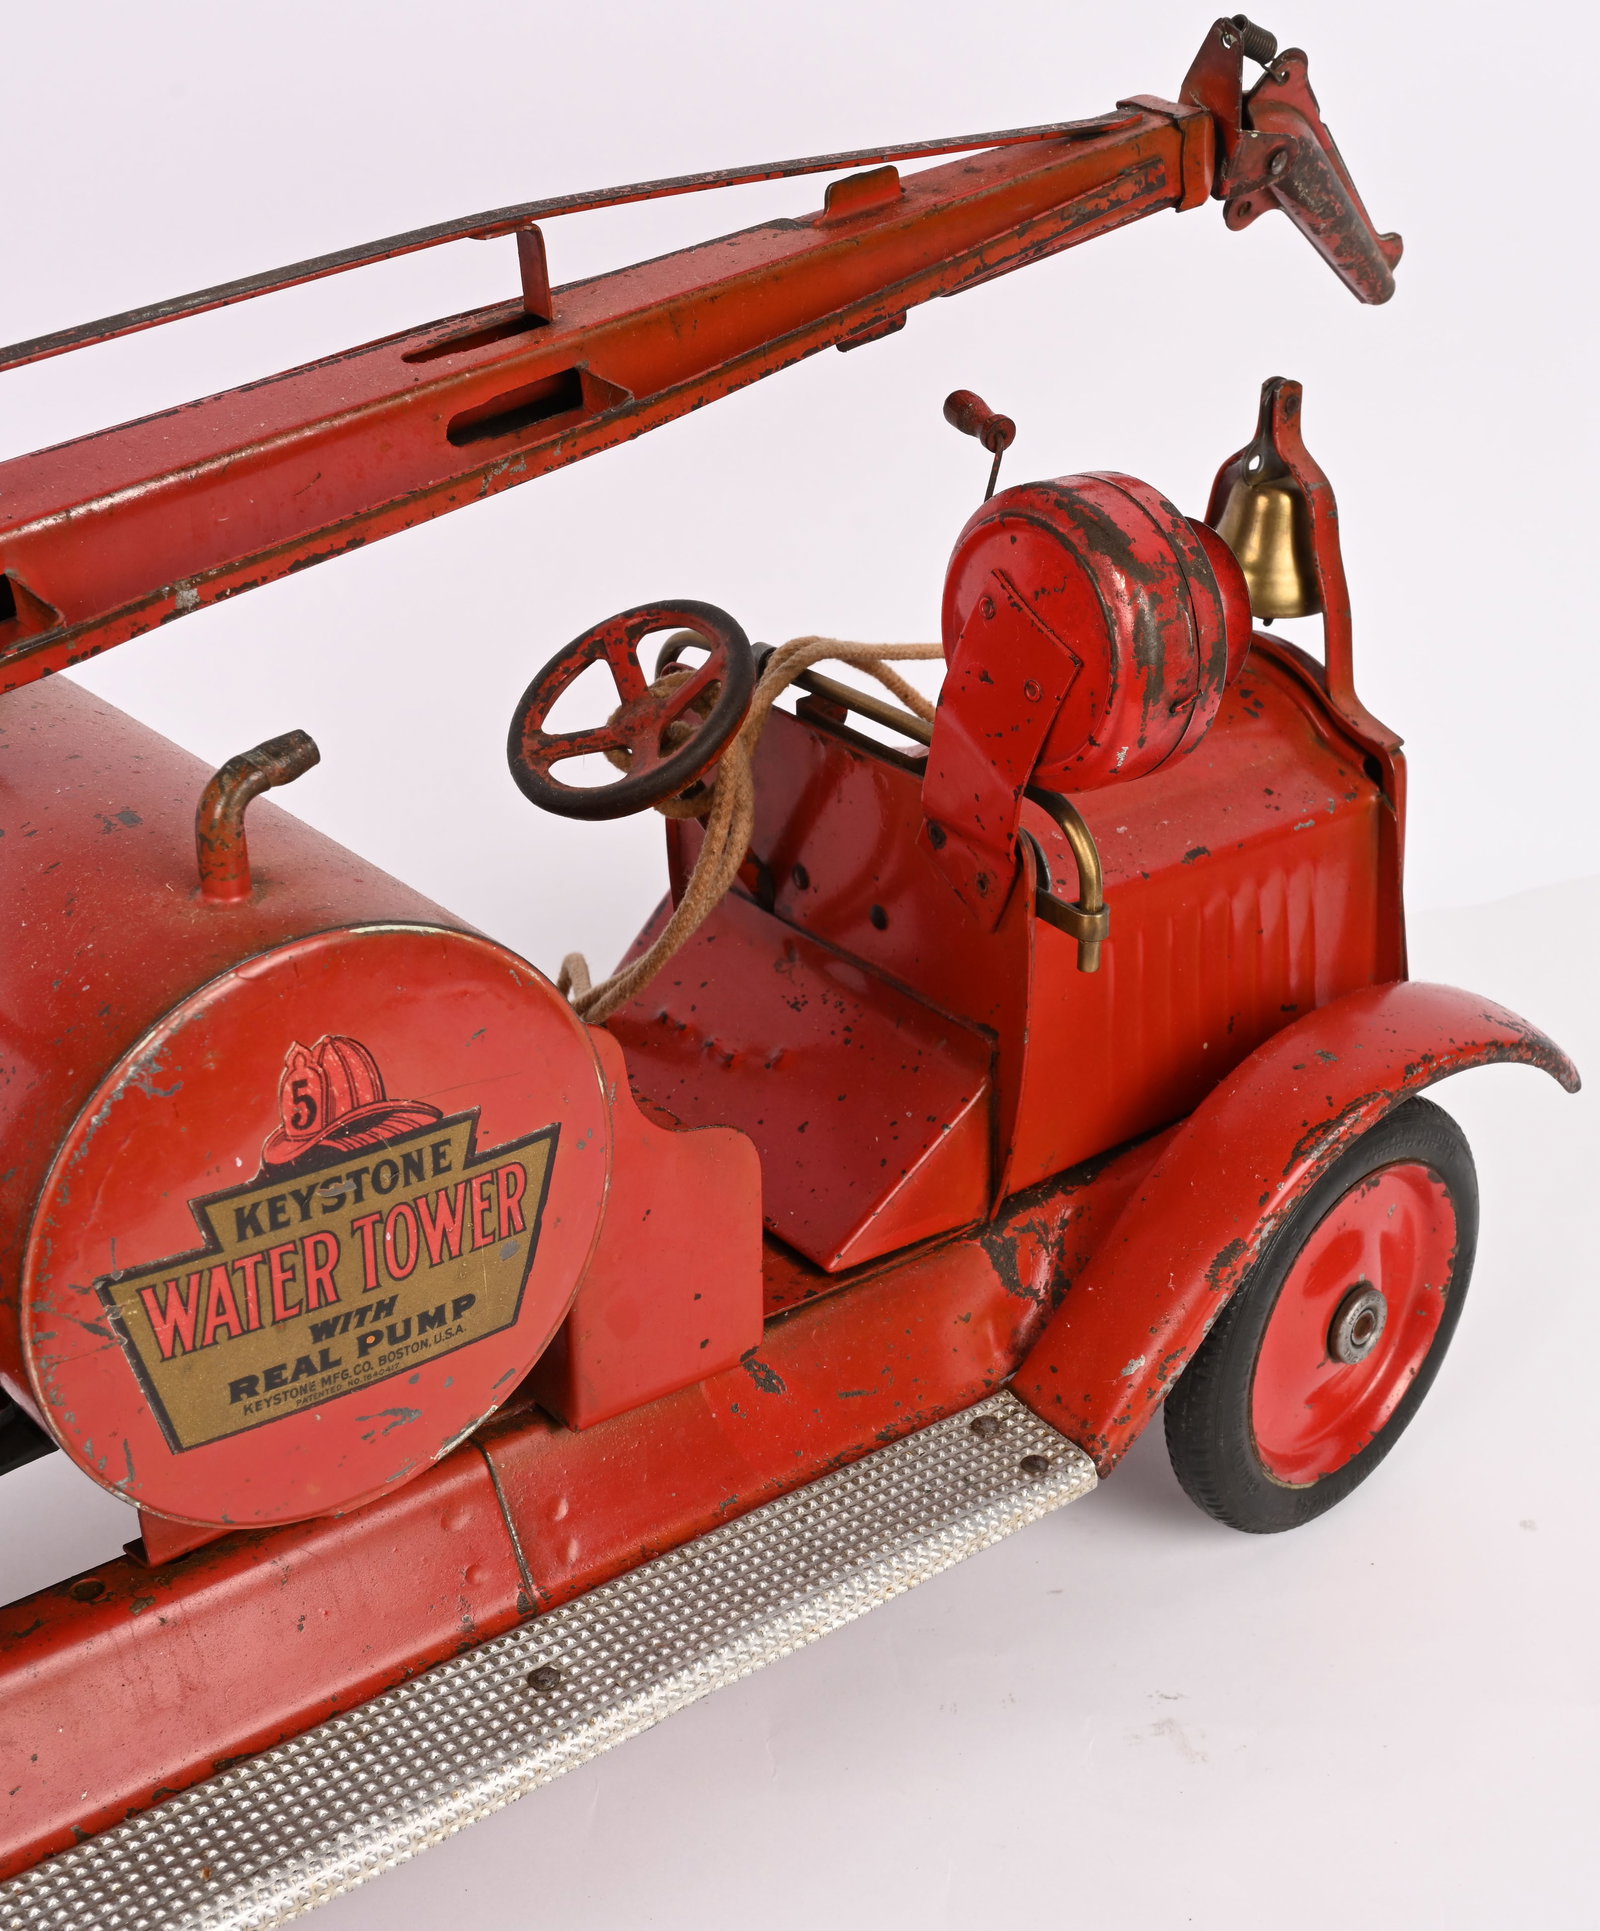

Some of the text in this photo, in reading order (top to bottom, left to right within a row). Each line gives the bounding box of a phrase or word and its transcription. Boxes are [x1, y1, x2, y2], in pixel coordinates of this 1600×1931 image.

[291, 1079, 317, 1129] 5
[234, 1139, 452, 1242] KEYSTONE
[137, 1161, 527, 1362] WATER TOWER
[311, 1294, 399, 1344] WITH
[229, 1293, 477, 1405] REAL PUMP
[243, 1380, 317, 1416] KEYSTONE
[296, 1385, 342, 1407] PATENTED
